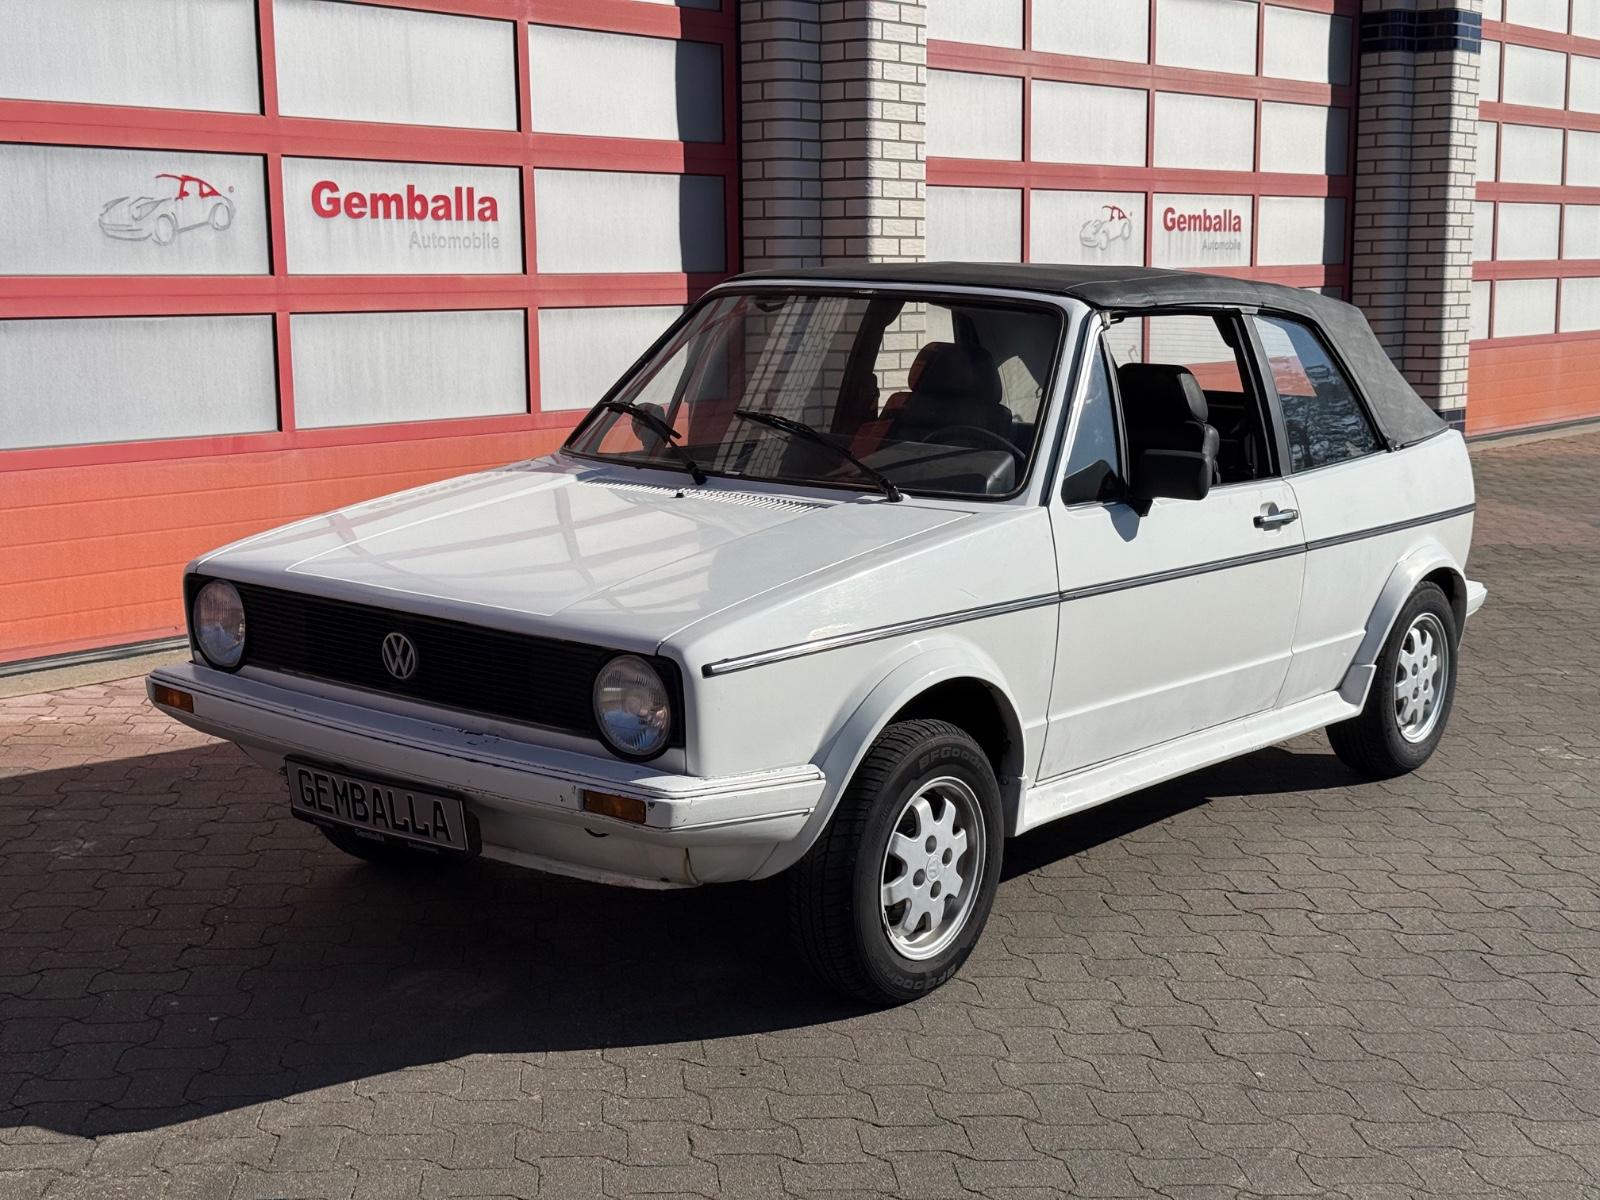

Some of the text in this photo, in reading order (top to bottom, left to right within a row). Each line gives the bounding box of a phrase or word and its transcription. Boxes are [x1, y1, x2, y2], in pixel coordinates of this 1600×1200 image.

[311, 180, 499, 222] Gemballa
[1162, 206, 1242, 232] Gemballa
[408, 231, 500, 249] Automobile
[1202, 239, 1241, 251] Automobile
[297, 768, 453, 841] GEMBALLA
